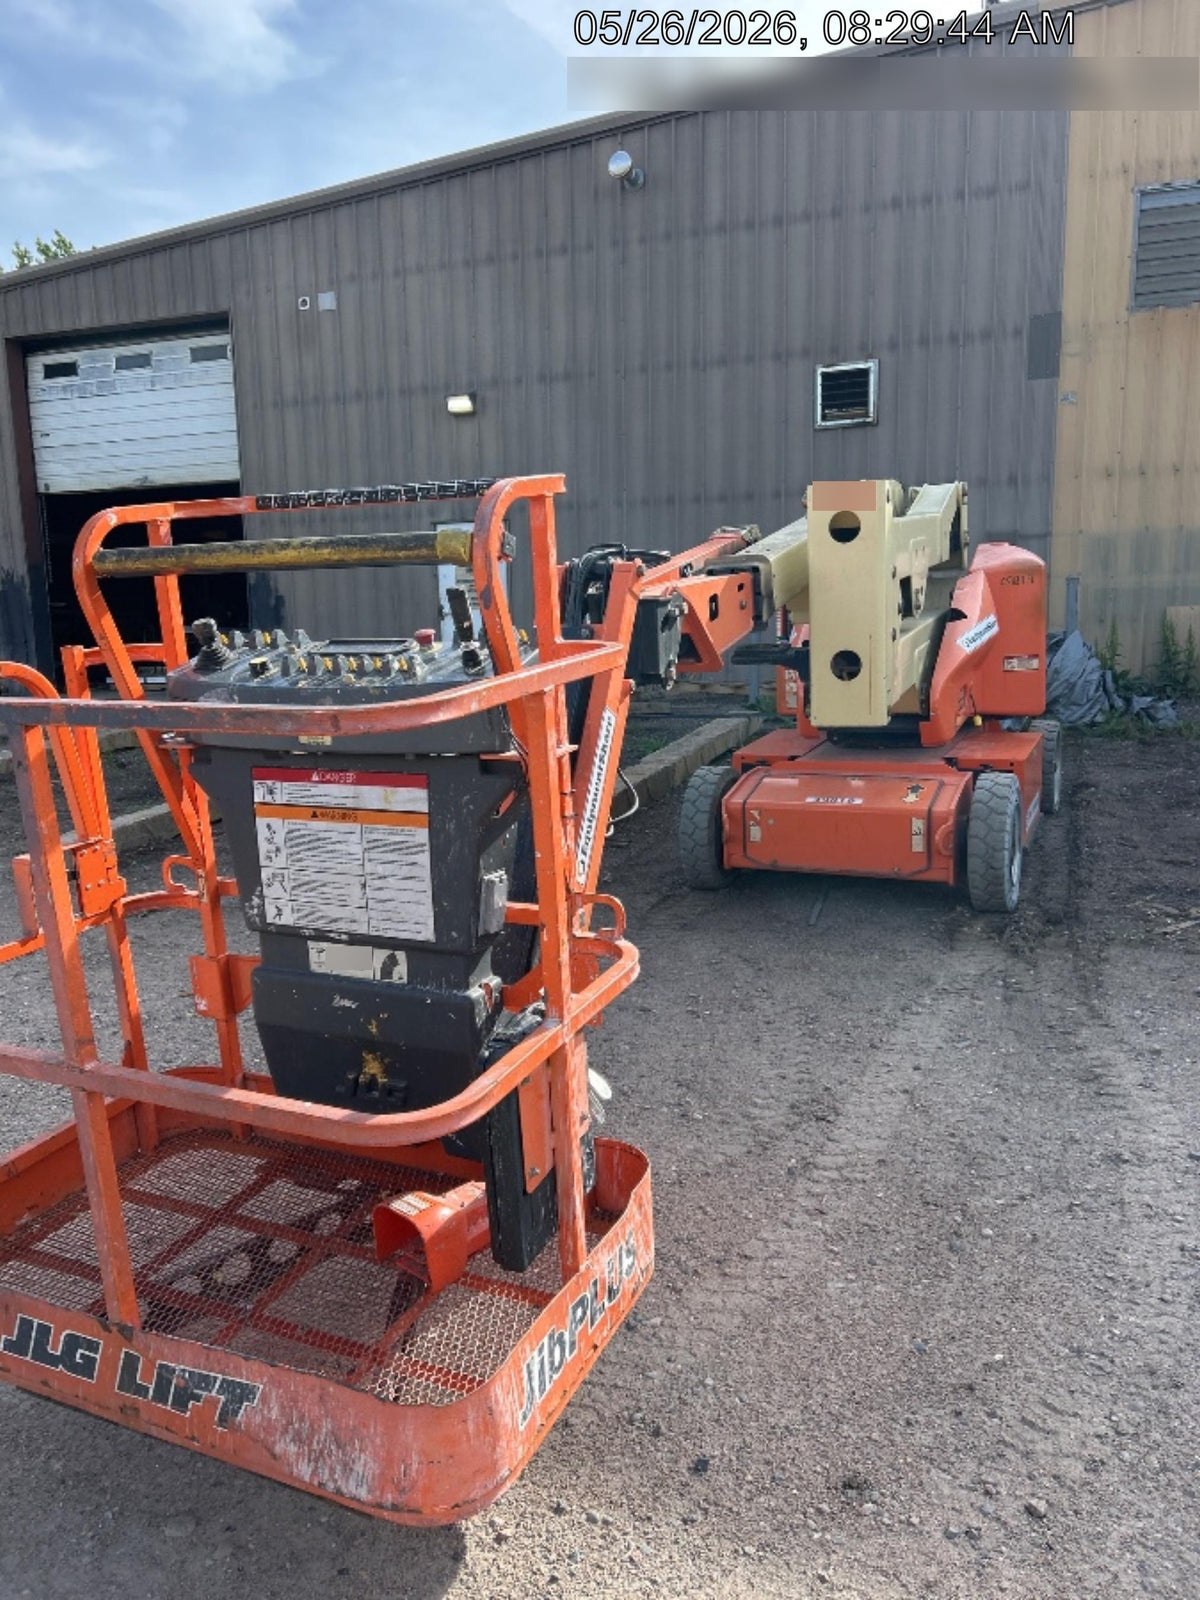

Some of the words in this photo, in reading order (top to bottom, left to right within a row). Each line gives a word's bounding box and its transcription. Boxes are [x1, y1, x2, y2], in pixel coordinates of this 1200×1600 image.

[319, 771, 357, 783] DANGER
[0, 1313, 104, 1384] JLG
[115, 1347, 264, 1432] LIFT
